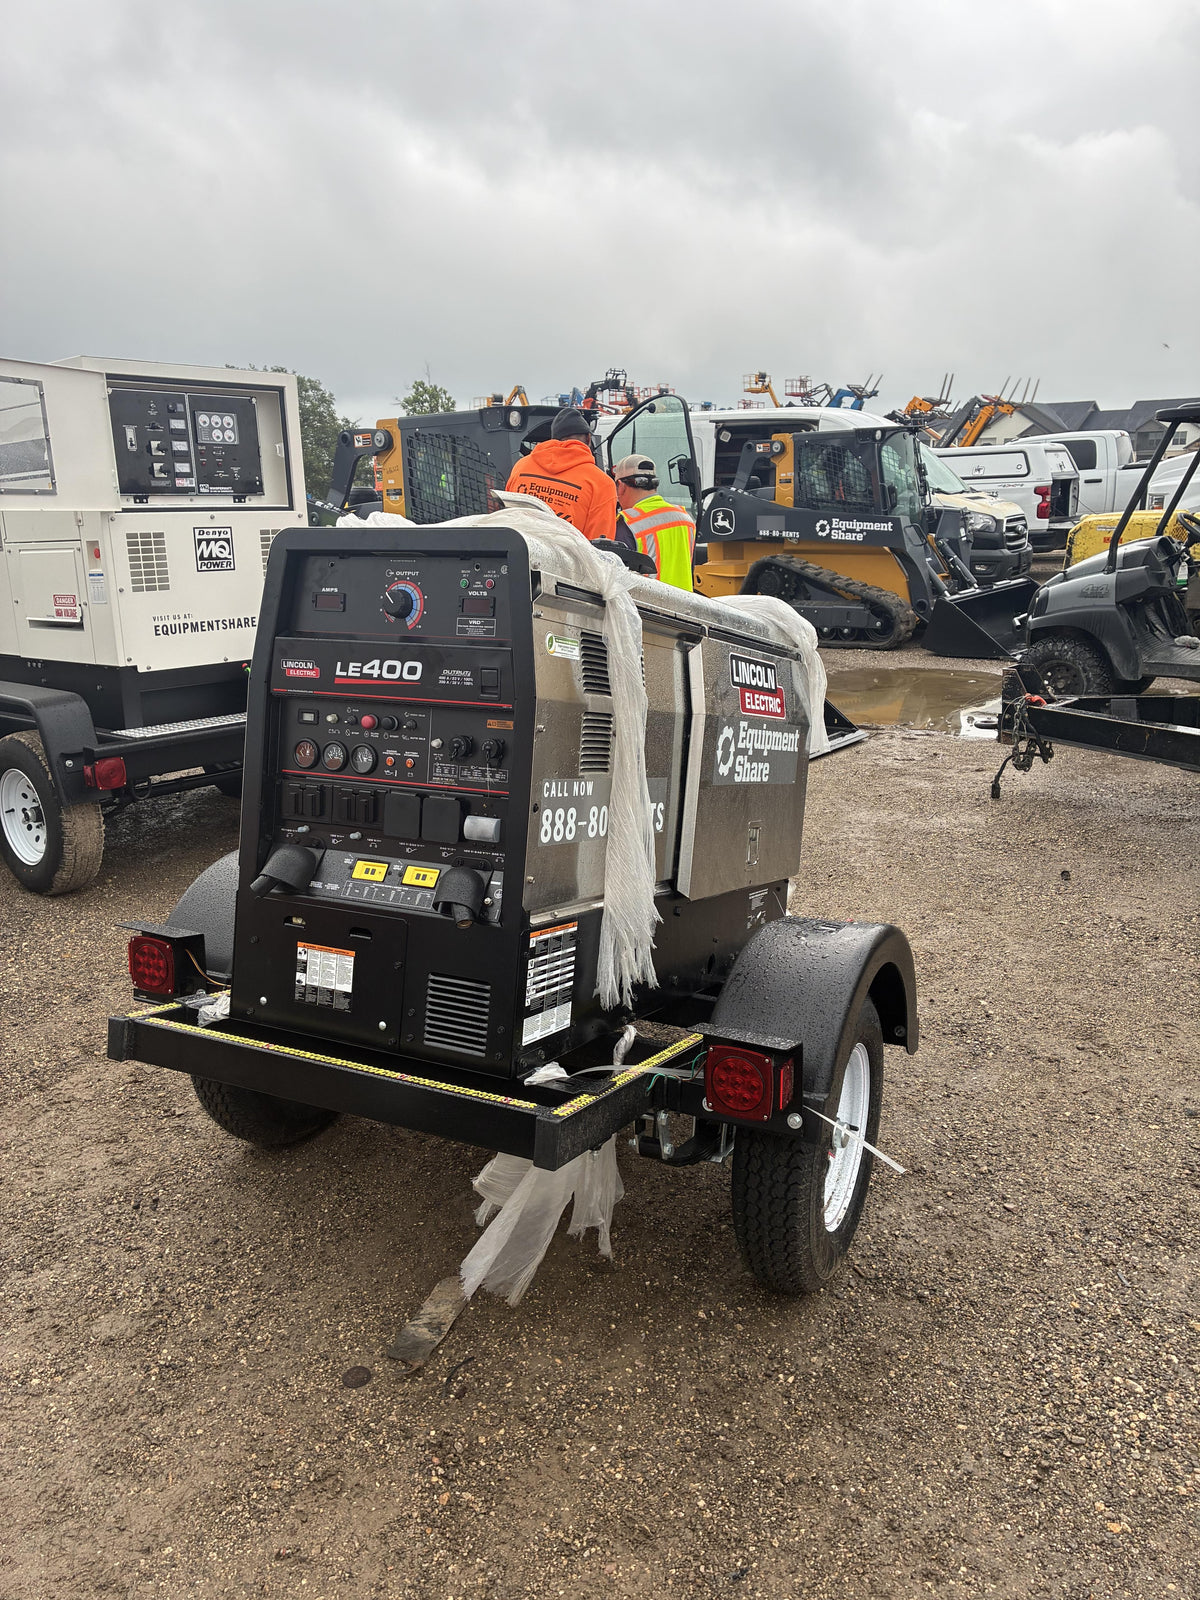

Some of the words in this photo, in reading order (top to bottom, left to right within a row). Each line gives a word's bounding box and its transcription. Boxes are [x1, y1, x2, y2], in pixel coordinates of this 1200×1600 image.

[529, 482, 579, 503] Equipment
[198, 529, 228, 537] Denyo
[831, 518, 894, 532] Equipment
[199, 540, 232, 559] MQ
[200, 561, 232, 569] POWER
[154, 616, 257, 637] EQUIPMENTSHARE
[282, 660, 313, 669] LINCOLN
[289, 669, 317, 677] ELECTRIC
[335, 659, 423, 681] LE400
[732, 659, 776, 690] LINCOLN
[745, 692, 781, 713] ELECTRIC
[737, 721, 800, 756] Equipment
[734, 755, 770, 782] Share
[543, 781, 569, 798] CALL
[572, 780, 594, 796] NOW
